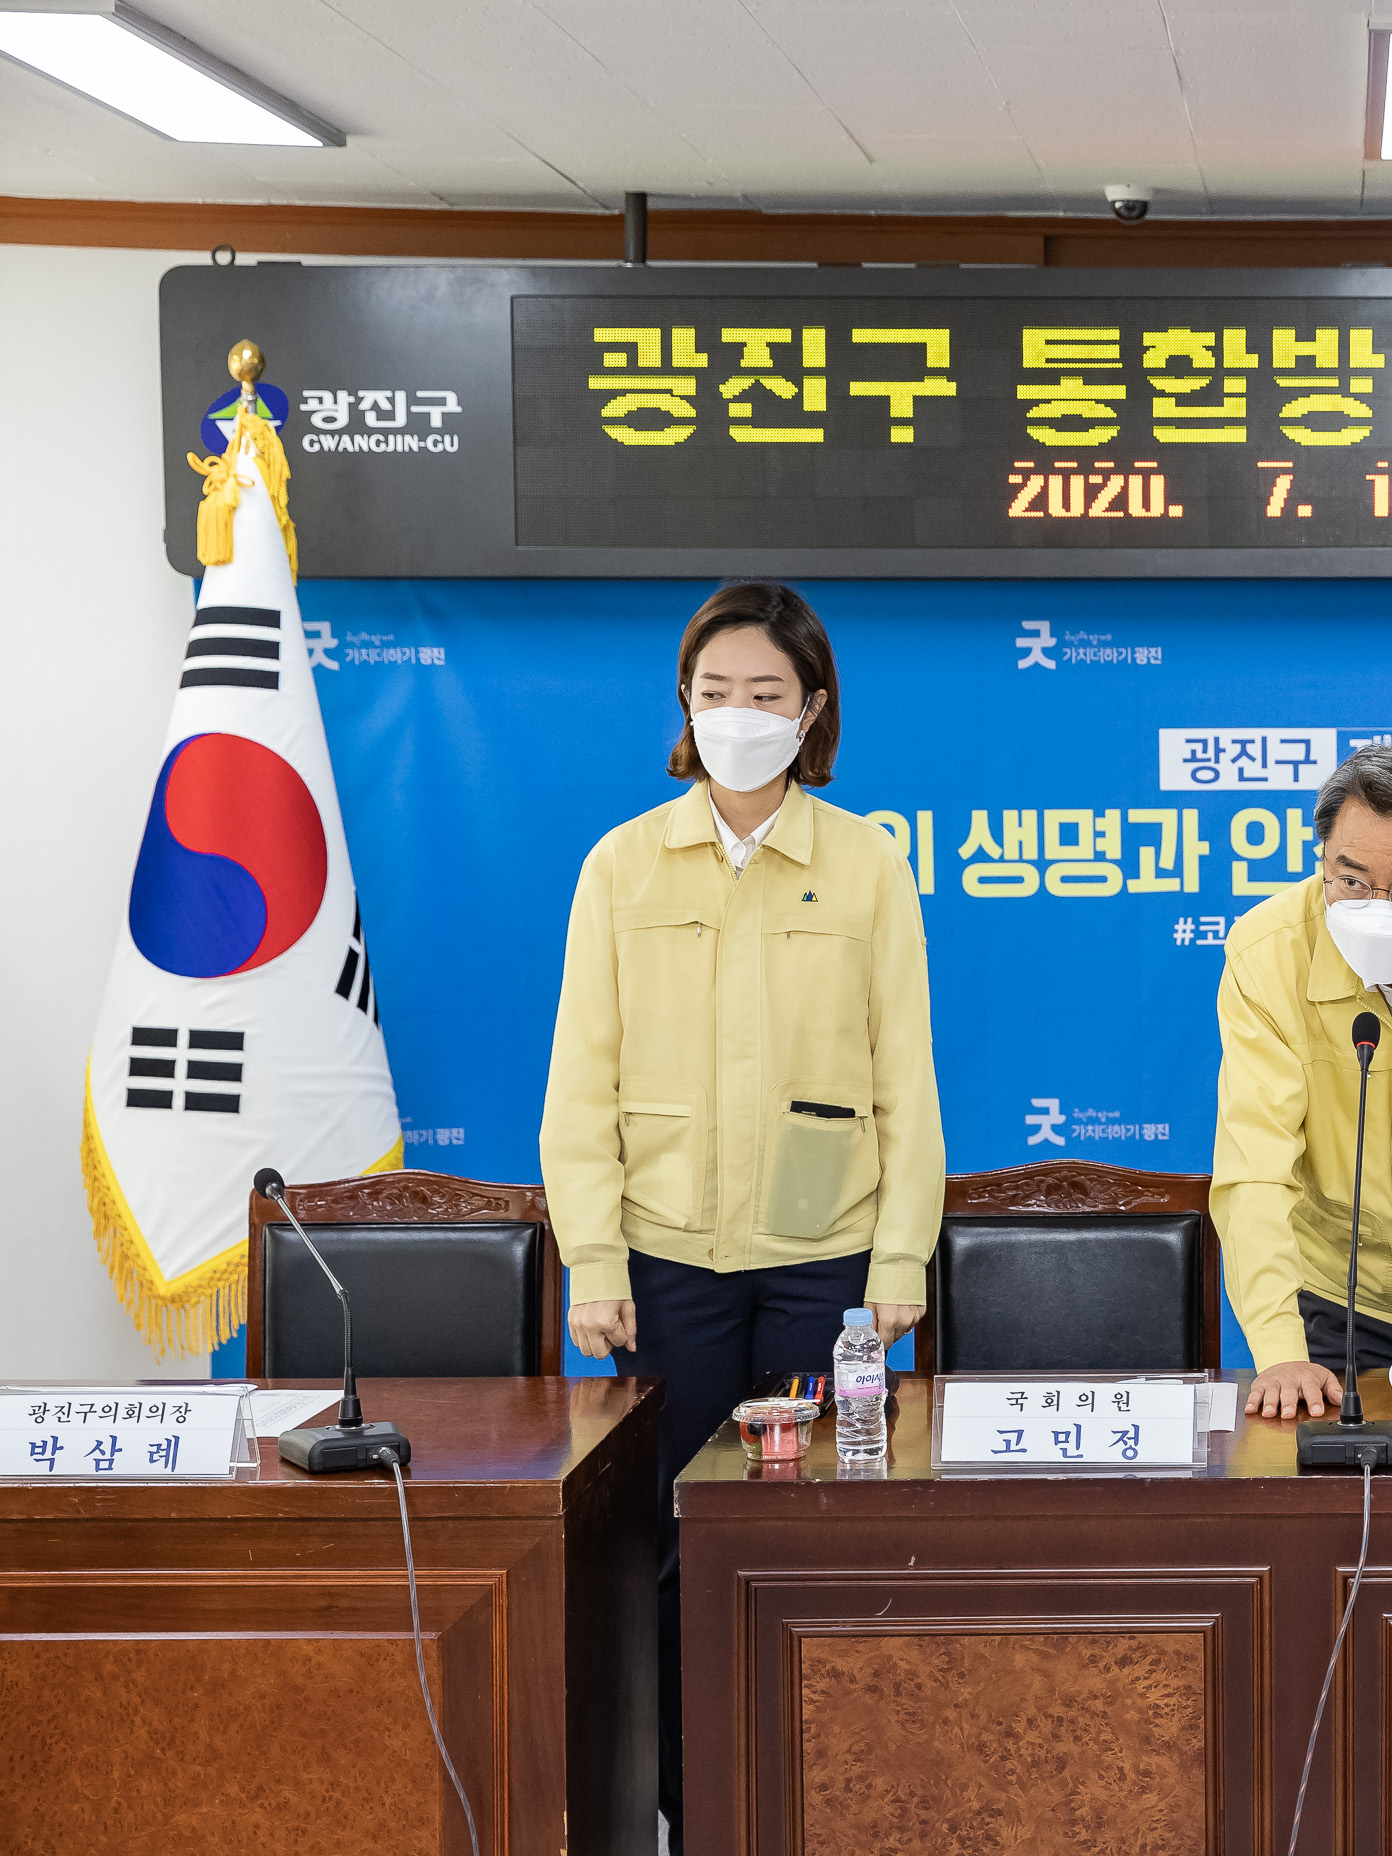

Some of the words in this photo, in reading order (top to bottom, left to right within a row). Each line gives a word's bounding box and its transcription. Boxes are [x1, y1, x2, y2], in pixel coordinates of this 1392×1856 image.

[588, 324, 957, 446] 광진구
[299, 388, 463, 429] 광진구
[301, 433, 459, 453] GWANGJIN-GU
[1007, 460, 1184, 518] 2020.
[1256, 460, 1314, 518] 7.
[417, 646, 446, 666] 광진
[1062, 646, 1132, 664] 가치더하기
[1133, 646, 1162, 665] 광진
[1182, 735, 1318, 785] 광진구
[958, 808, 1210, 898] 생명과
[1071, 1123, 1140, 1141] 가치더하기
[1141, 1122, 1170, 1141] 광진
[28, 1401, 192, 1425] 광진구의회의장
